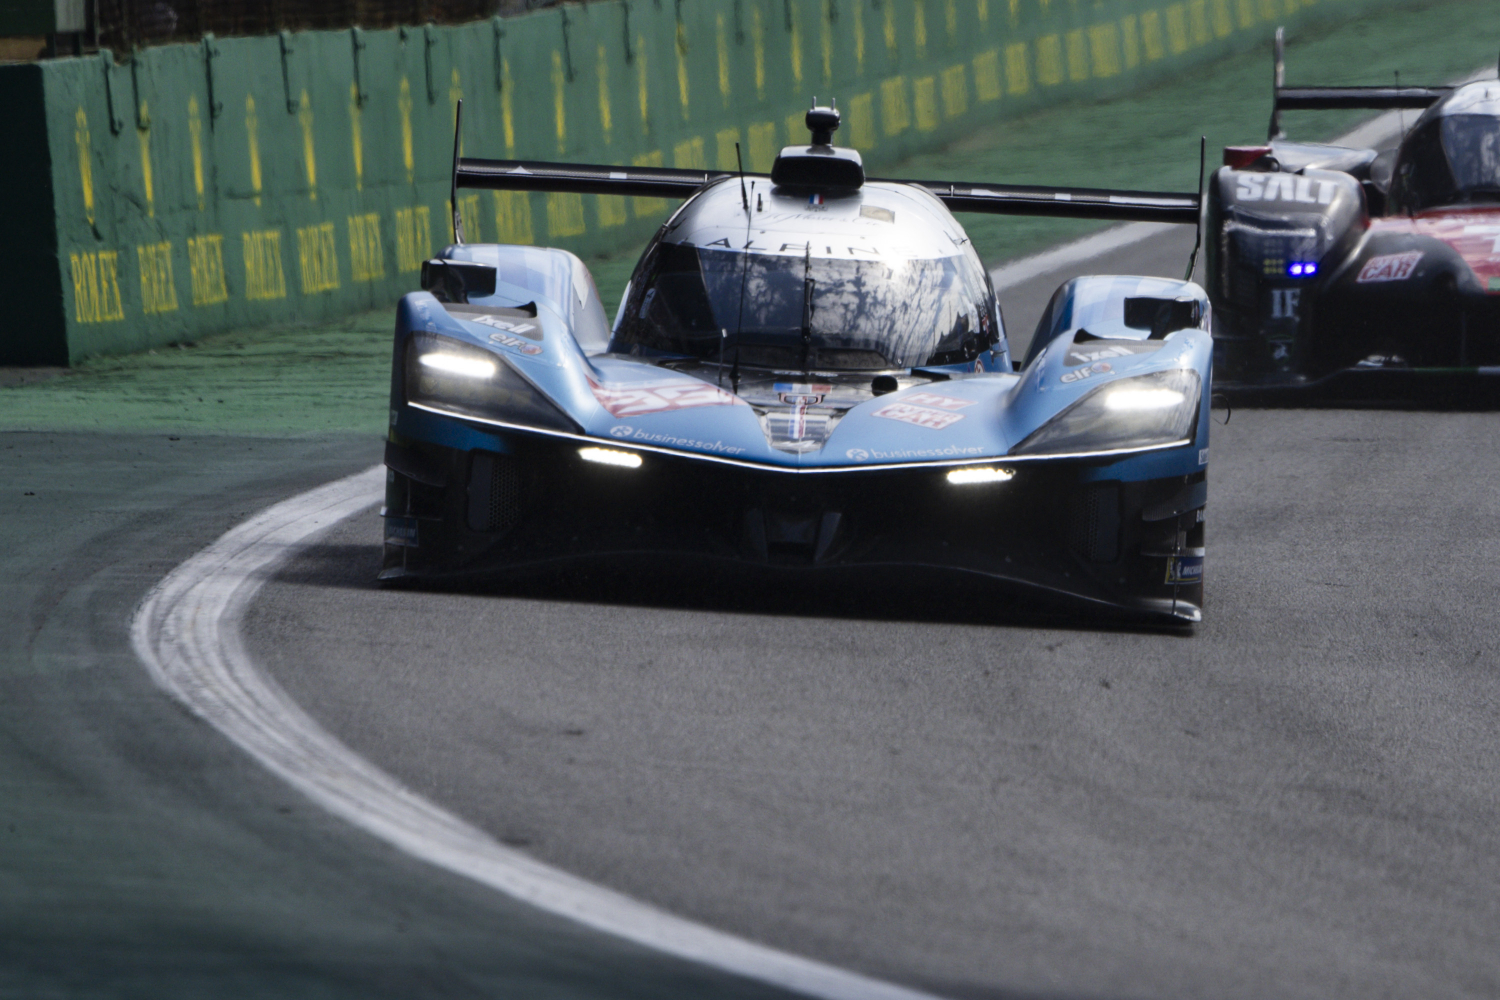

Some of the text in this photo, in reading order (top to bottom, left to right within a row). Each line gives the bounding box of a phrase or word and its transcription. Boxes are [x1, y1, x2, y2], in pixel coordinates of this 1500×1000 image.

[1236, 174, 1339, 205] SALT
[1360, 262, 1412, 281] CAR
[70, 251, 125, 322] ROLEX
[879, 408, 948, 428] CAR
[633, 428, 747, 456] businessolver
[870, 445, 985, 460] businessolver
